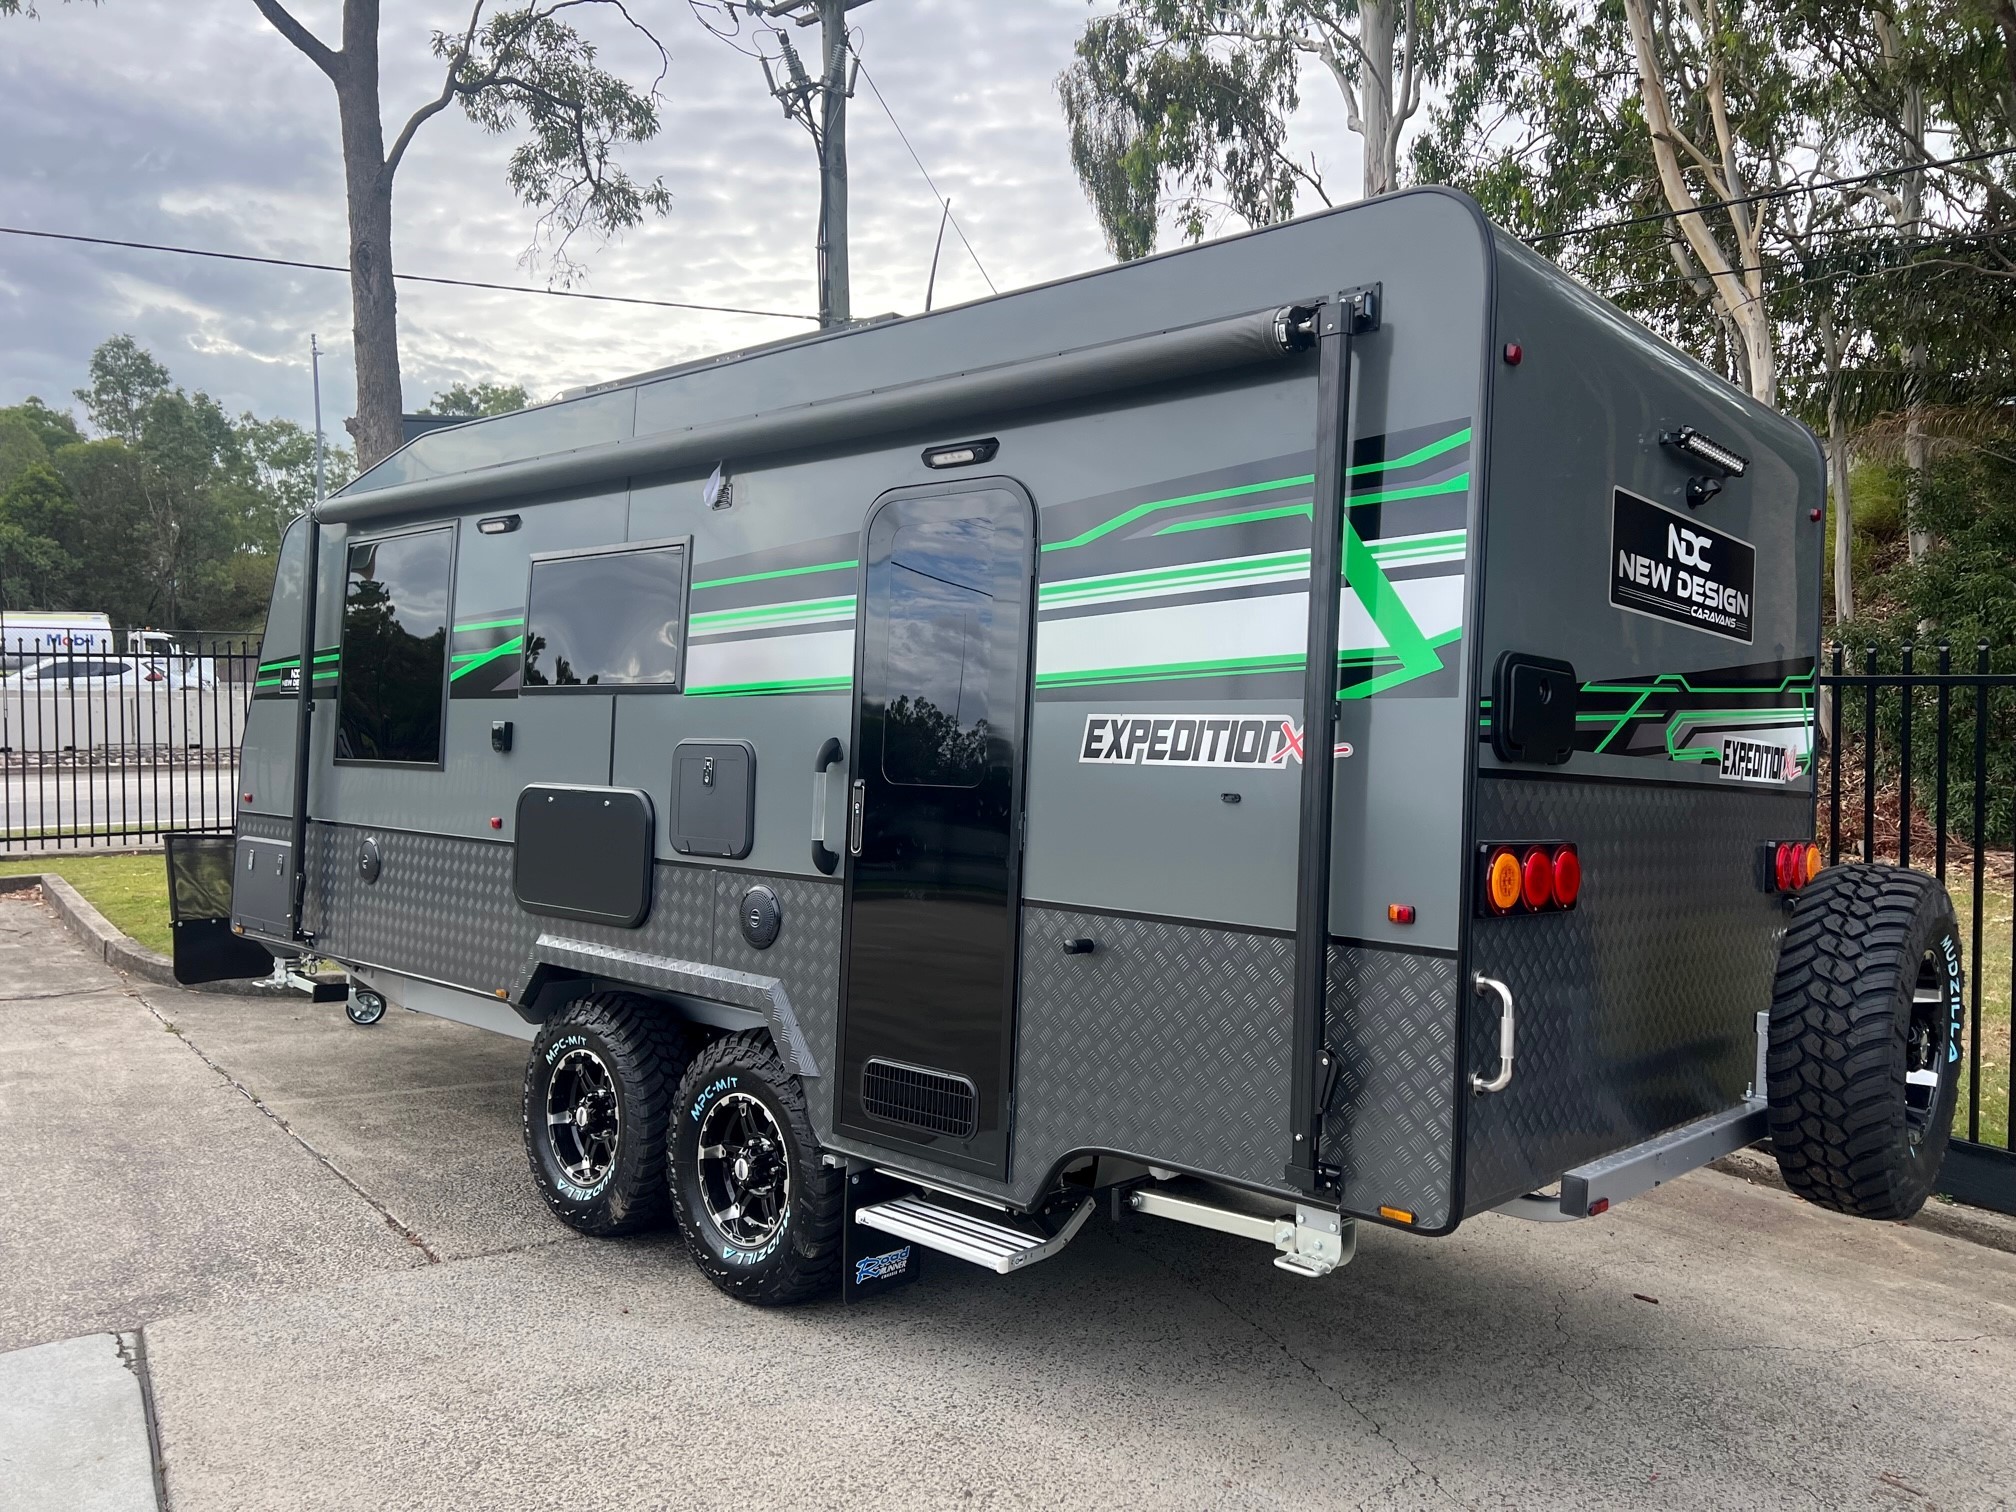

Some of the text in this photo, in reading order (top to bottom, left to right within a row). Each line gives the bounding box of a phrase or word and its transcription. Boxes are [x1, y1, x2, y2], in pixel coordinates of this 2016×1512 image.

[1668, 523, 1712, 573] NDC
[1619, 550, 1749, 618] NEW DESIGN
[1690, 606, 1736, 628] CARAVANS
[1083, 719, 1290, 764] EXPEDITION
[1721, 739, 1787, 781] EXPEDITION
[1940, 934, 1961, 1064] MUDZILLA
[545, 1035, 587, 1065] MPC-M/T
[690, 1076, 738, 1122] MPC-M/T
[557, 1159, 615, 1201] MUDZILLA
[722, 1203, 791, 1265] MUDZILLA
[856, 1245, 911, 1285] Road
